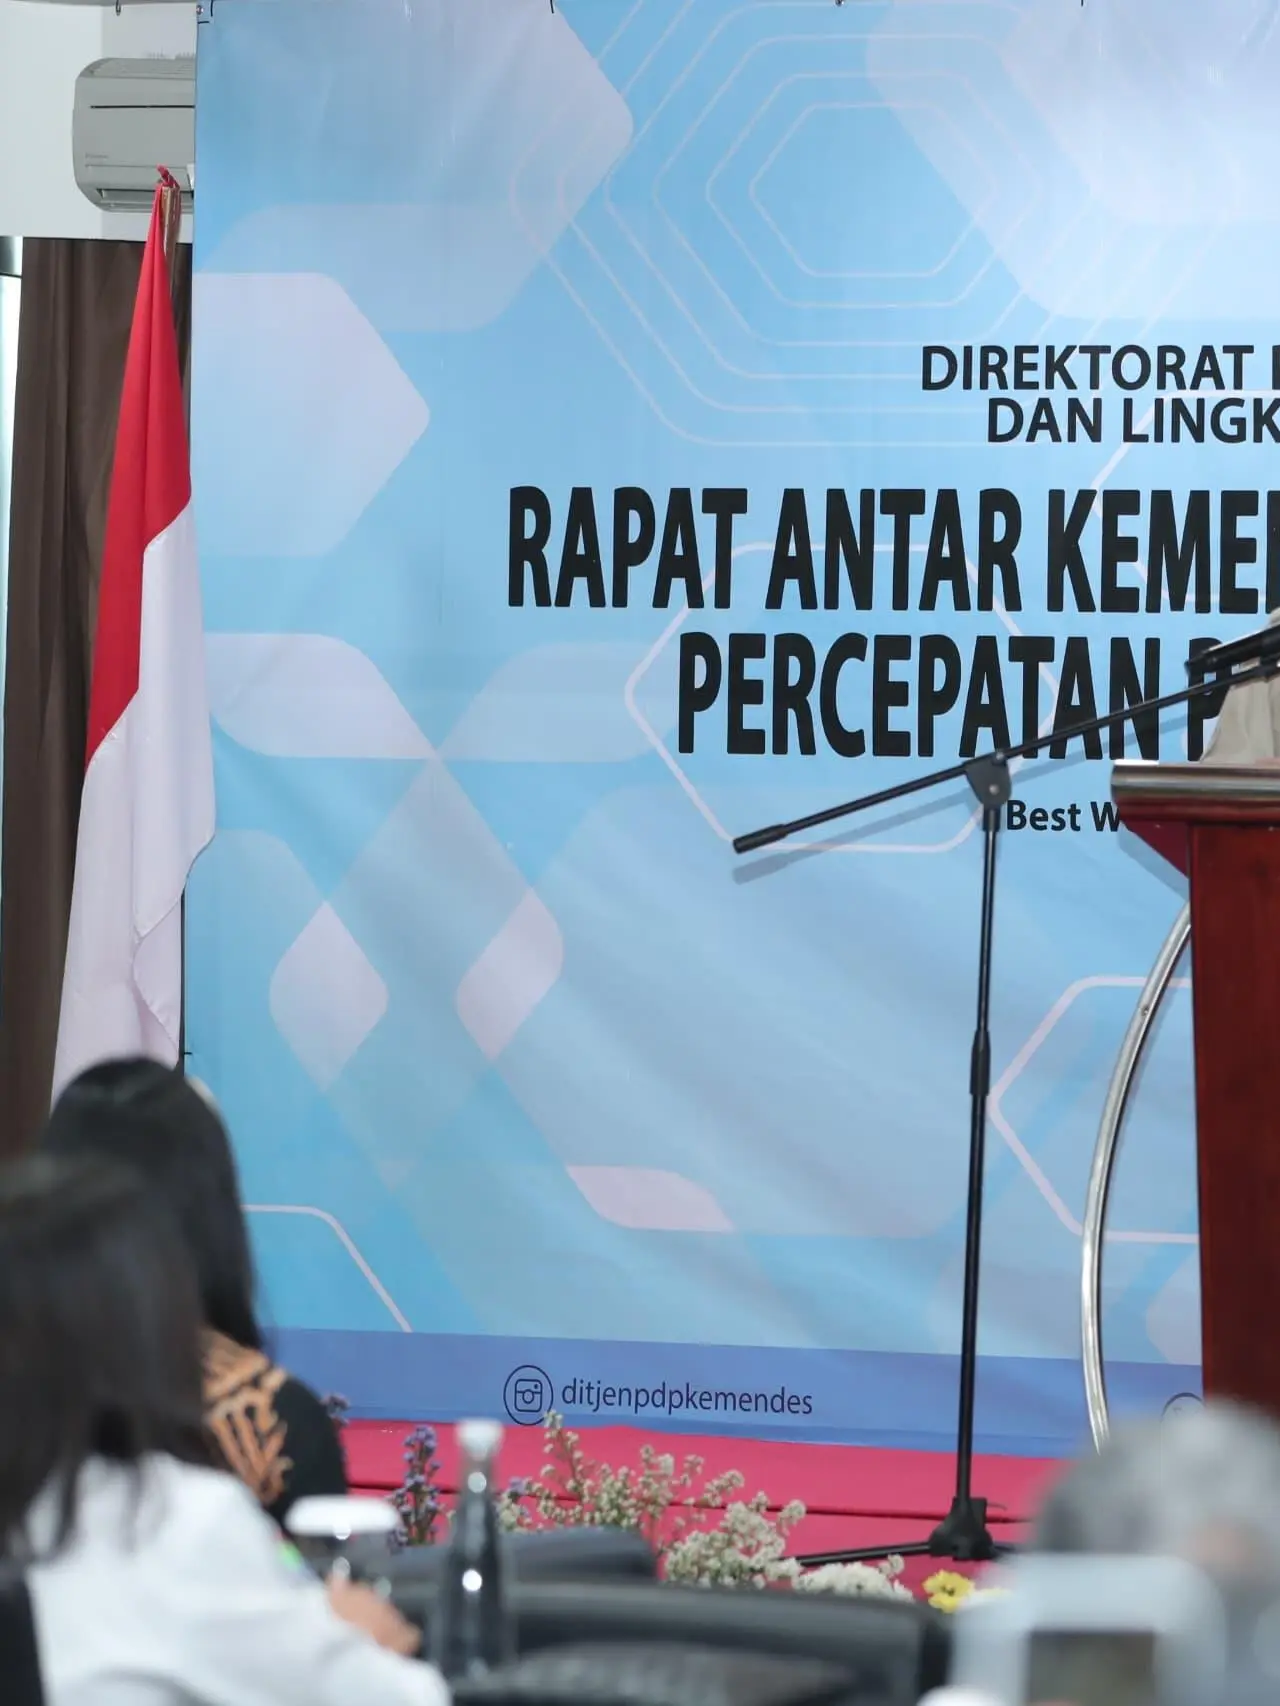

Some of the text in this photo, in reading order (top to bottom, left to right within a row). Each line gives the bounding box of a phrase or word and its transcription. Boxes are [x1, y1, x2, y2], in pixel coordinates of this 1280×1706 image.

[922, 344, 1255, 391] DIREKTORAT
[987, 397, 1102, 443] DAN
[508, 485, 748, 610] RAPAT
[764, 487, 1023, 612] ANTAR
[678, 631, 1161, 761] PERCEPATAN
[1006, 799, 1081, 831] Best
[561, 1377, 813, 1416] ditjenpdpkemendes
